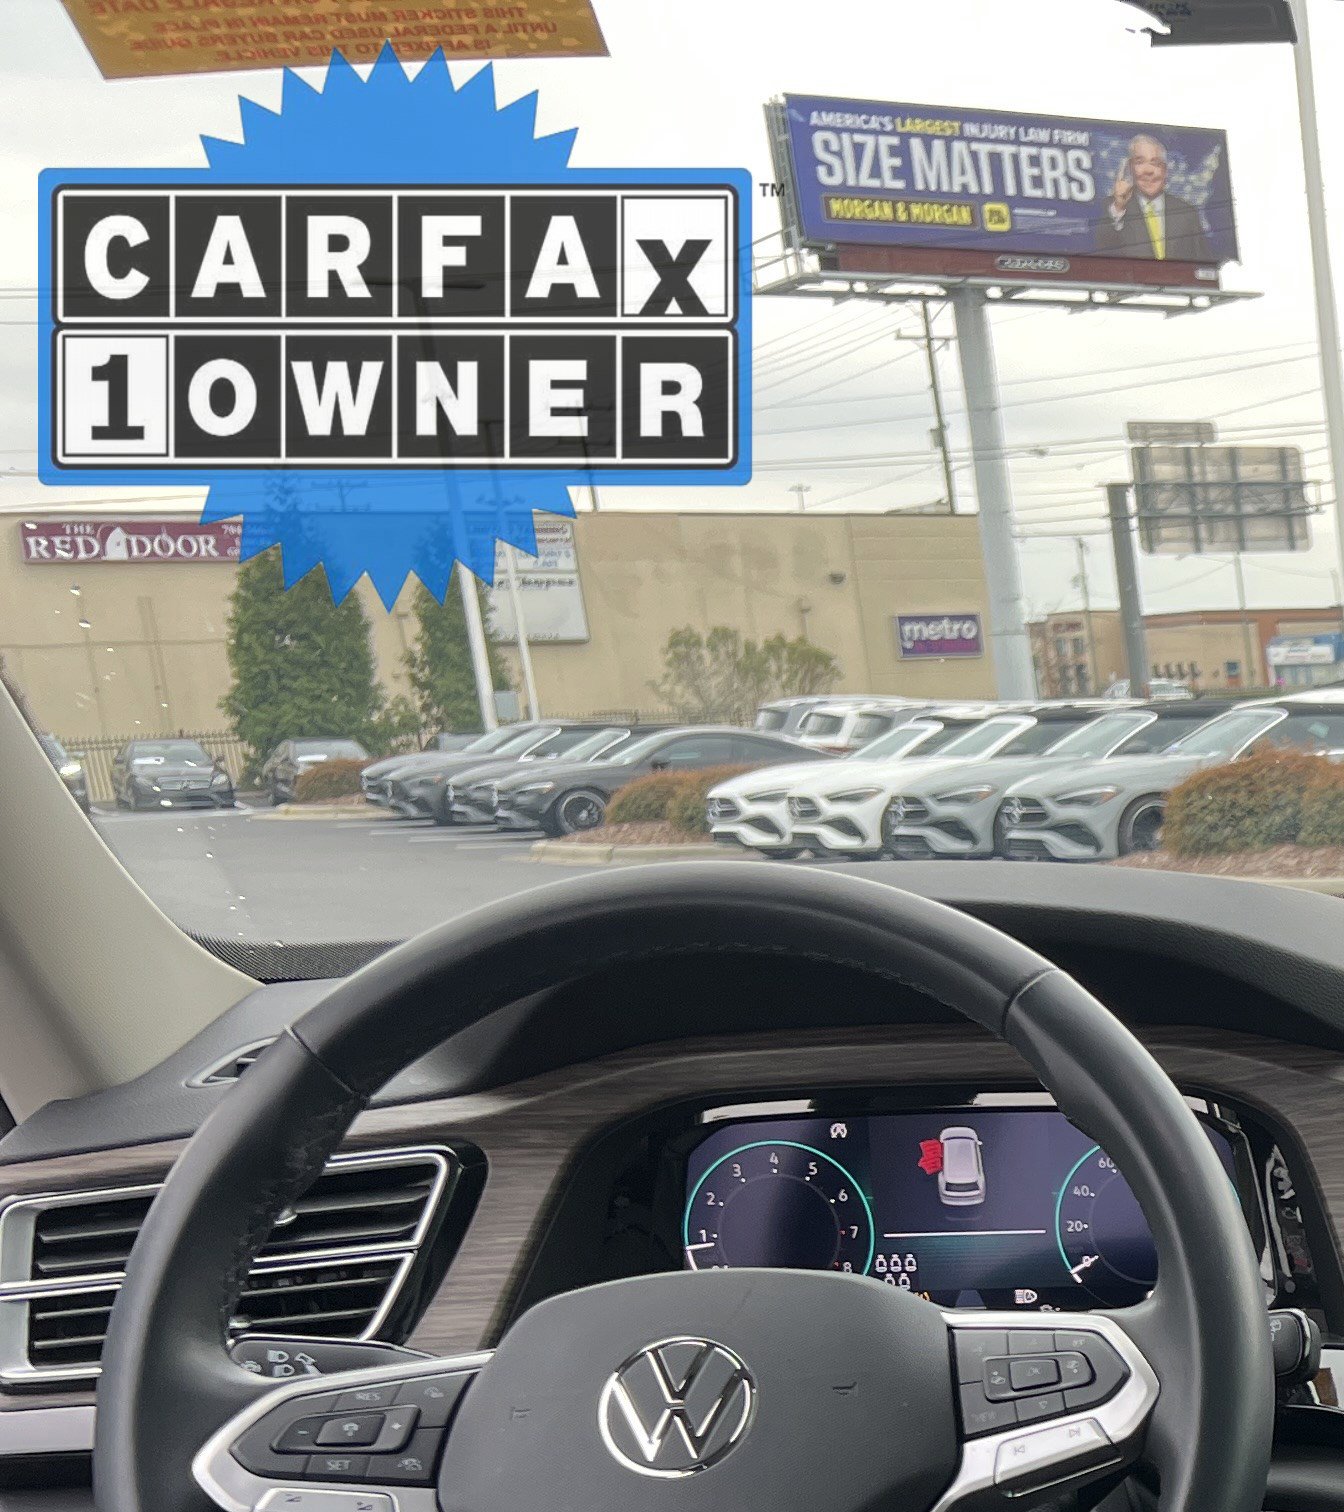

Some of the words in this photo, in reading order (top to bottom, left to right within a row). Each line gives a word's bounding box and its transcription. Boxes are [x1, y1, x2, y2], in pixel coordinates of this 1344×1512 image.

[809, 111, 894, 131] AMERICA'S
[895, 117, 961, 136] LARGEST
[963, 122, 1017, 140] INJURY
[1019, 126, 1051, 143] LAW
[1053, 129, 1090, 146] FIRM
[811, 130, 906, 190] SIZE
[909, 136, 1096, 202] MATTERS
[829, 198, 894, 220] MORGAN
[895, 201, 908, 222] &
[909, 202, 973, 226] MORGAN
[62, 523, 94, 535] THE
[26, 535, 100, 559] RED
[127, 533, 219, 558] DOOR
[901, 617, 978, 640] metro
[769, 1152, 779, 1165] 4
[732, 1163, 742, 1177] 3
[808, 1161, 818, 1175] 5
[838, 1188, 848, 1202] 6
[1073, 1185, 1090, 1197] 40
[706, 1192, 716, 1206] 2
[849, 1225, 859, 1239] 7
[1066, 1220, 1083, 1233] 20
[699, 1229, 707, 1243] 1
[327, 1459, 350, 1471] SET
